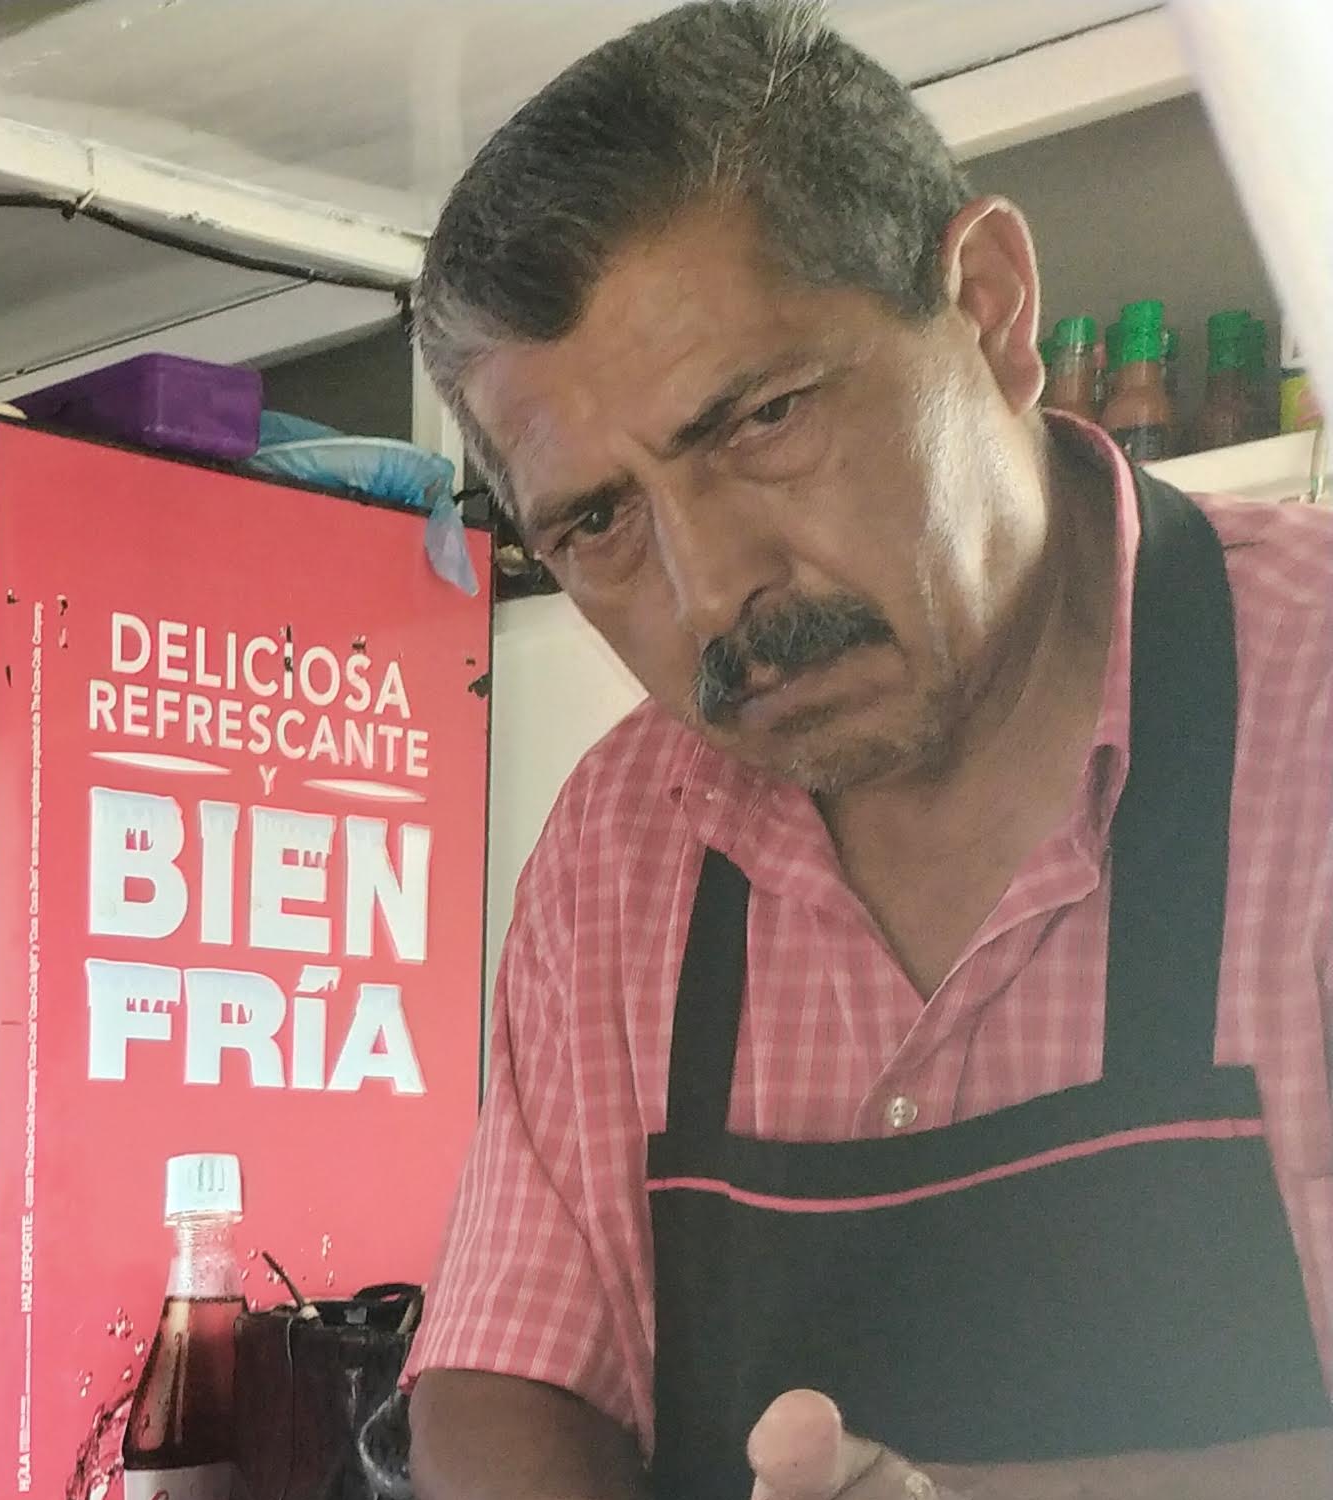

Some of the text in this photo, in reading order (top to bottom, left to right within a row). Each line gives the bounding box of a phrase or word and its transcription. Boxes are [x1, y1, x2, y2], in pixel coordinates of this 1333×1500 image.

[111, 612, 411, 719] DELICIOSA
[88, 680, 429, 777] REFRESCANTE
[259, 764, 277, 796] Y
[89, 786, 431, 964] BIEN
[85, 958, 427, 1096] FRÍA
[21, 1282, 33, 1311] HAZ
